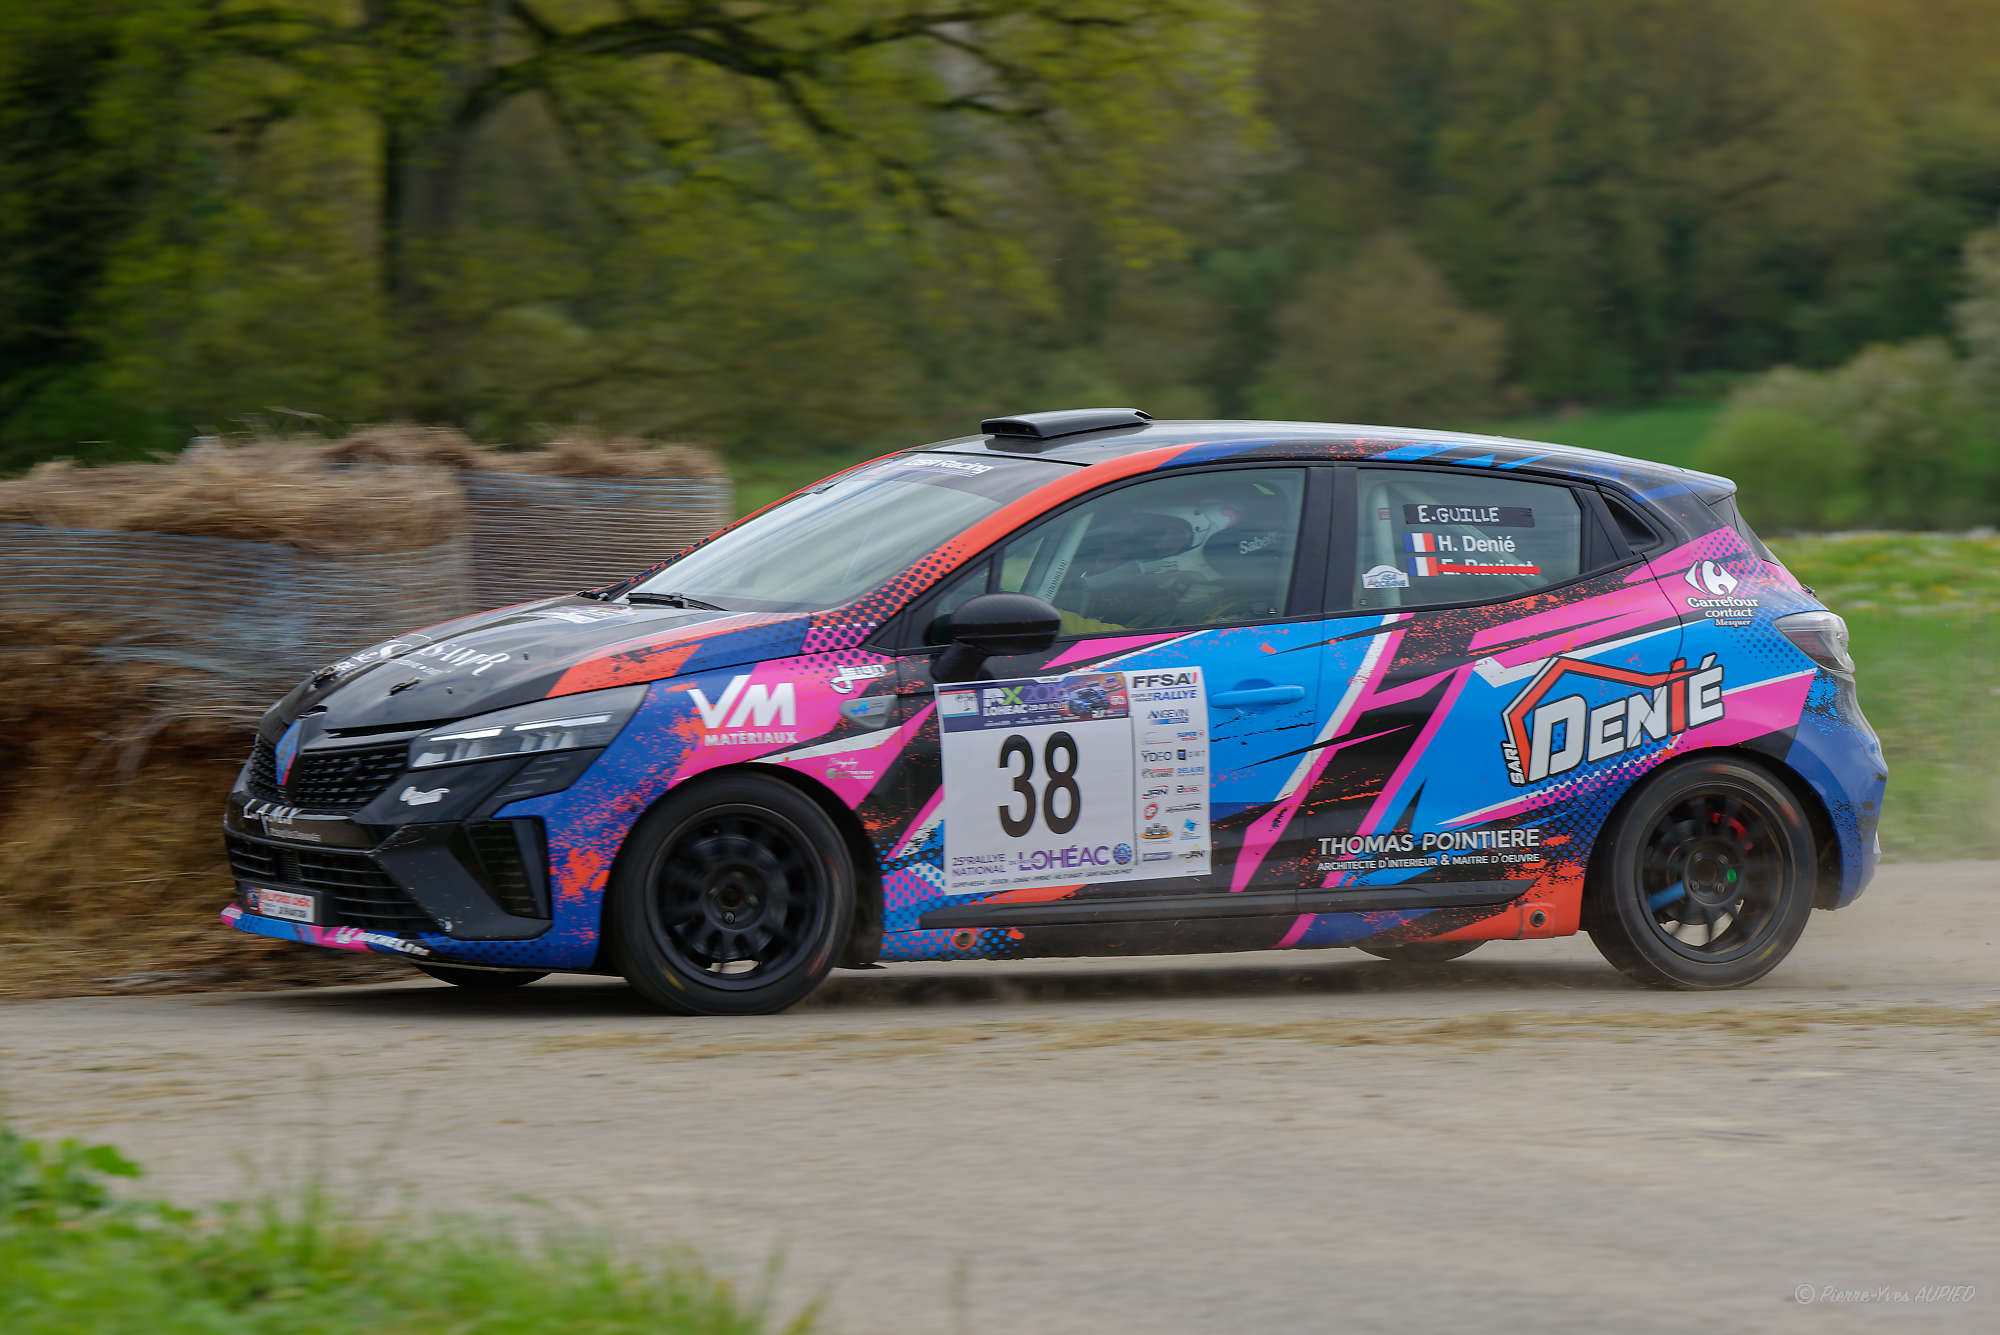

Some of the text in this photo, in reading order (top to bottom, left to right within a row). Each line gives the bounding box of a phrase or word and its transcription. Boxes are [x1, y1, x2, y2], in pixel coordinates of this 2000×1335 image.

[1438, 536, 1516, 552] H. Denié
[1687, 596, 1759, 610] Carrefour
[1705, 608, 1753, 619] contact
[1714, 618, 1752, 628] Mesquer
[687, 675, 797, 729] VM
[1153, 690, 1197, 701] RALLYE
[997, 731, 1081, 838] 38
[1318, 828, 1541, 855] THOMAS POINTIERE
[1019, 844, 1110, 871] LOHÉAC
[1317, 860, 1377, 872] ARCHITECTE
[1440, 854, 1450, 866] &
[951, 865, 1007, 876] NATIONAL
